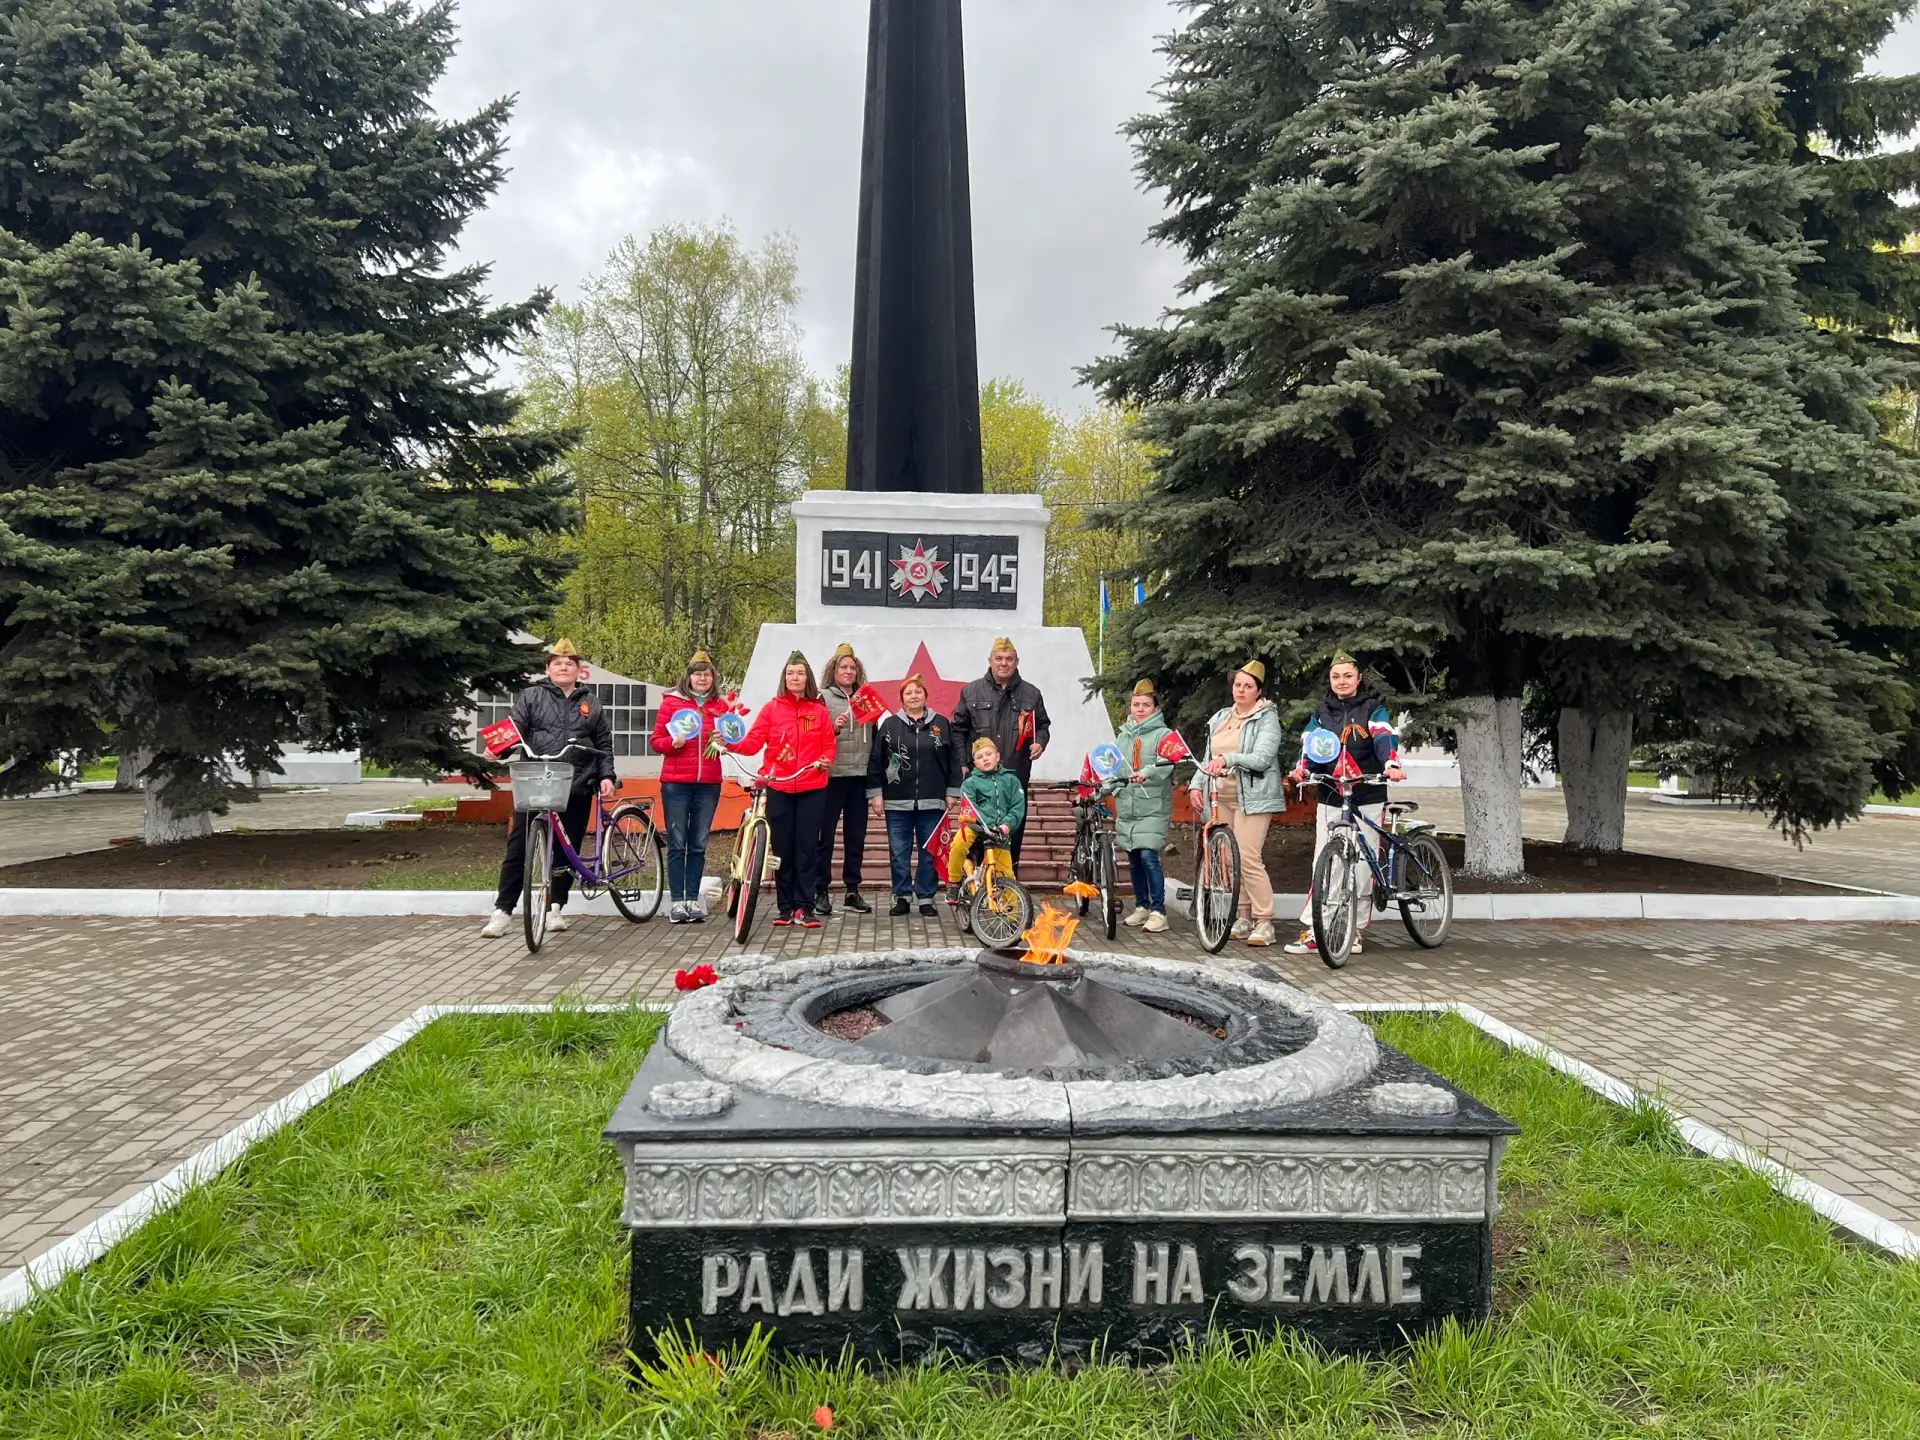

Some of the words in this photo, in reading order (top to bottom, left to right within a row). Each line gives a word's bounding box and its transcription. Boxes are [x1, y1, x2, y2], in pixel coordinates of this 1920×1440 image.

[823, 548, 882, 590] 1941
[953, 553, 1018, 593] 1945
[701, 1249, 864, 1317] РАДИ
[896, 1242, 1103, 1311] ЖИЗНИ
[1132, 1241, 1204, 1304] НА
[1227, 1243, 1422, 1304] ЗЕМЛЕ
